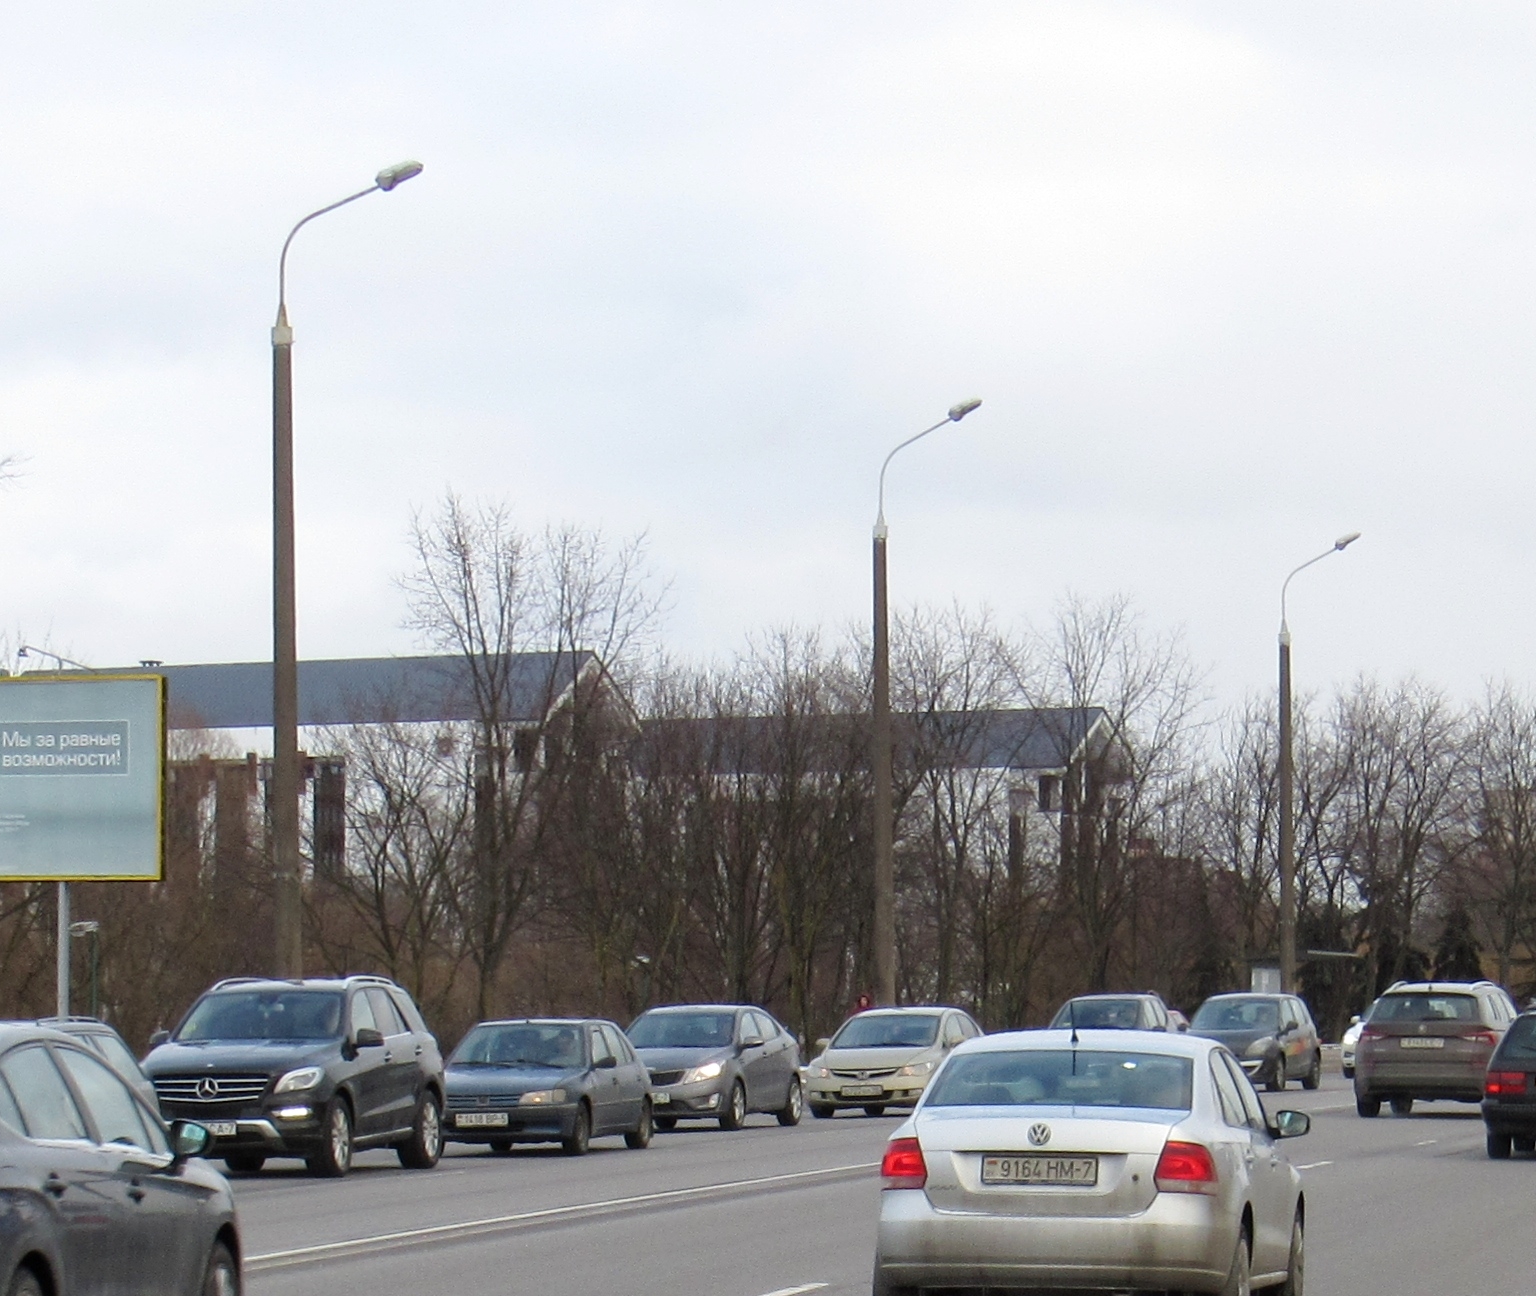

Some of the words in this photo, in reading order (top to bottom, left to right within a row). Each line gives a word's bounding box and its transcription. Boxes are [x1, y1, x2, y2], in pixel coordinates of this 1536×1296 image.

[2, 731, 31, 747] Мы
[35, 735, 55, 747] за
[60, 733, 121, 750] равные
[2, 750, 120, 767] возможности!
[1001, 1161, 1041, 1178] 9164
[1047, 1161, 1092, 1178] HM-7
